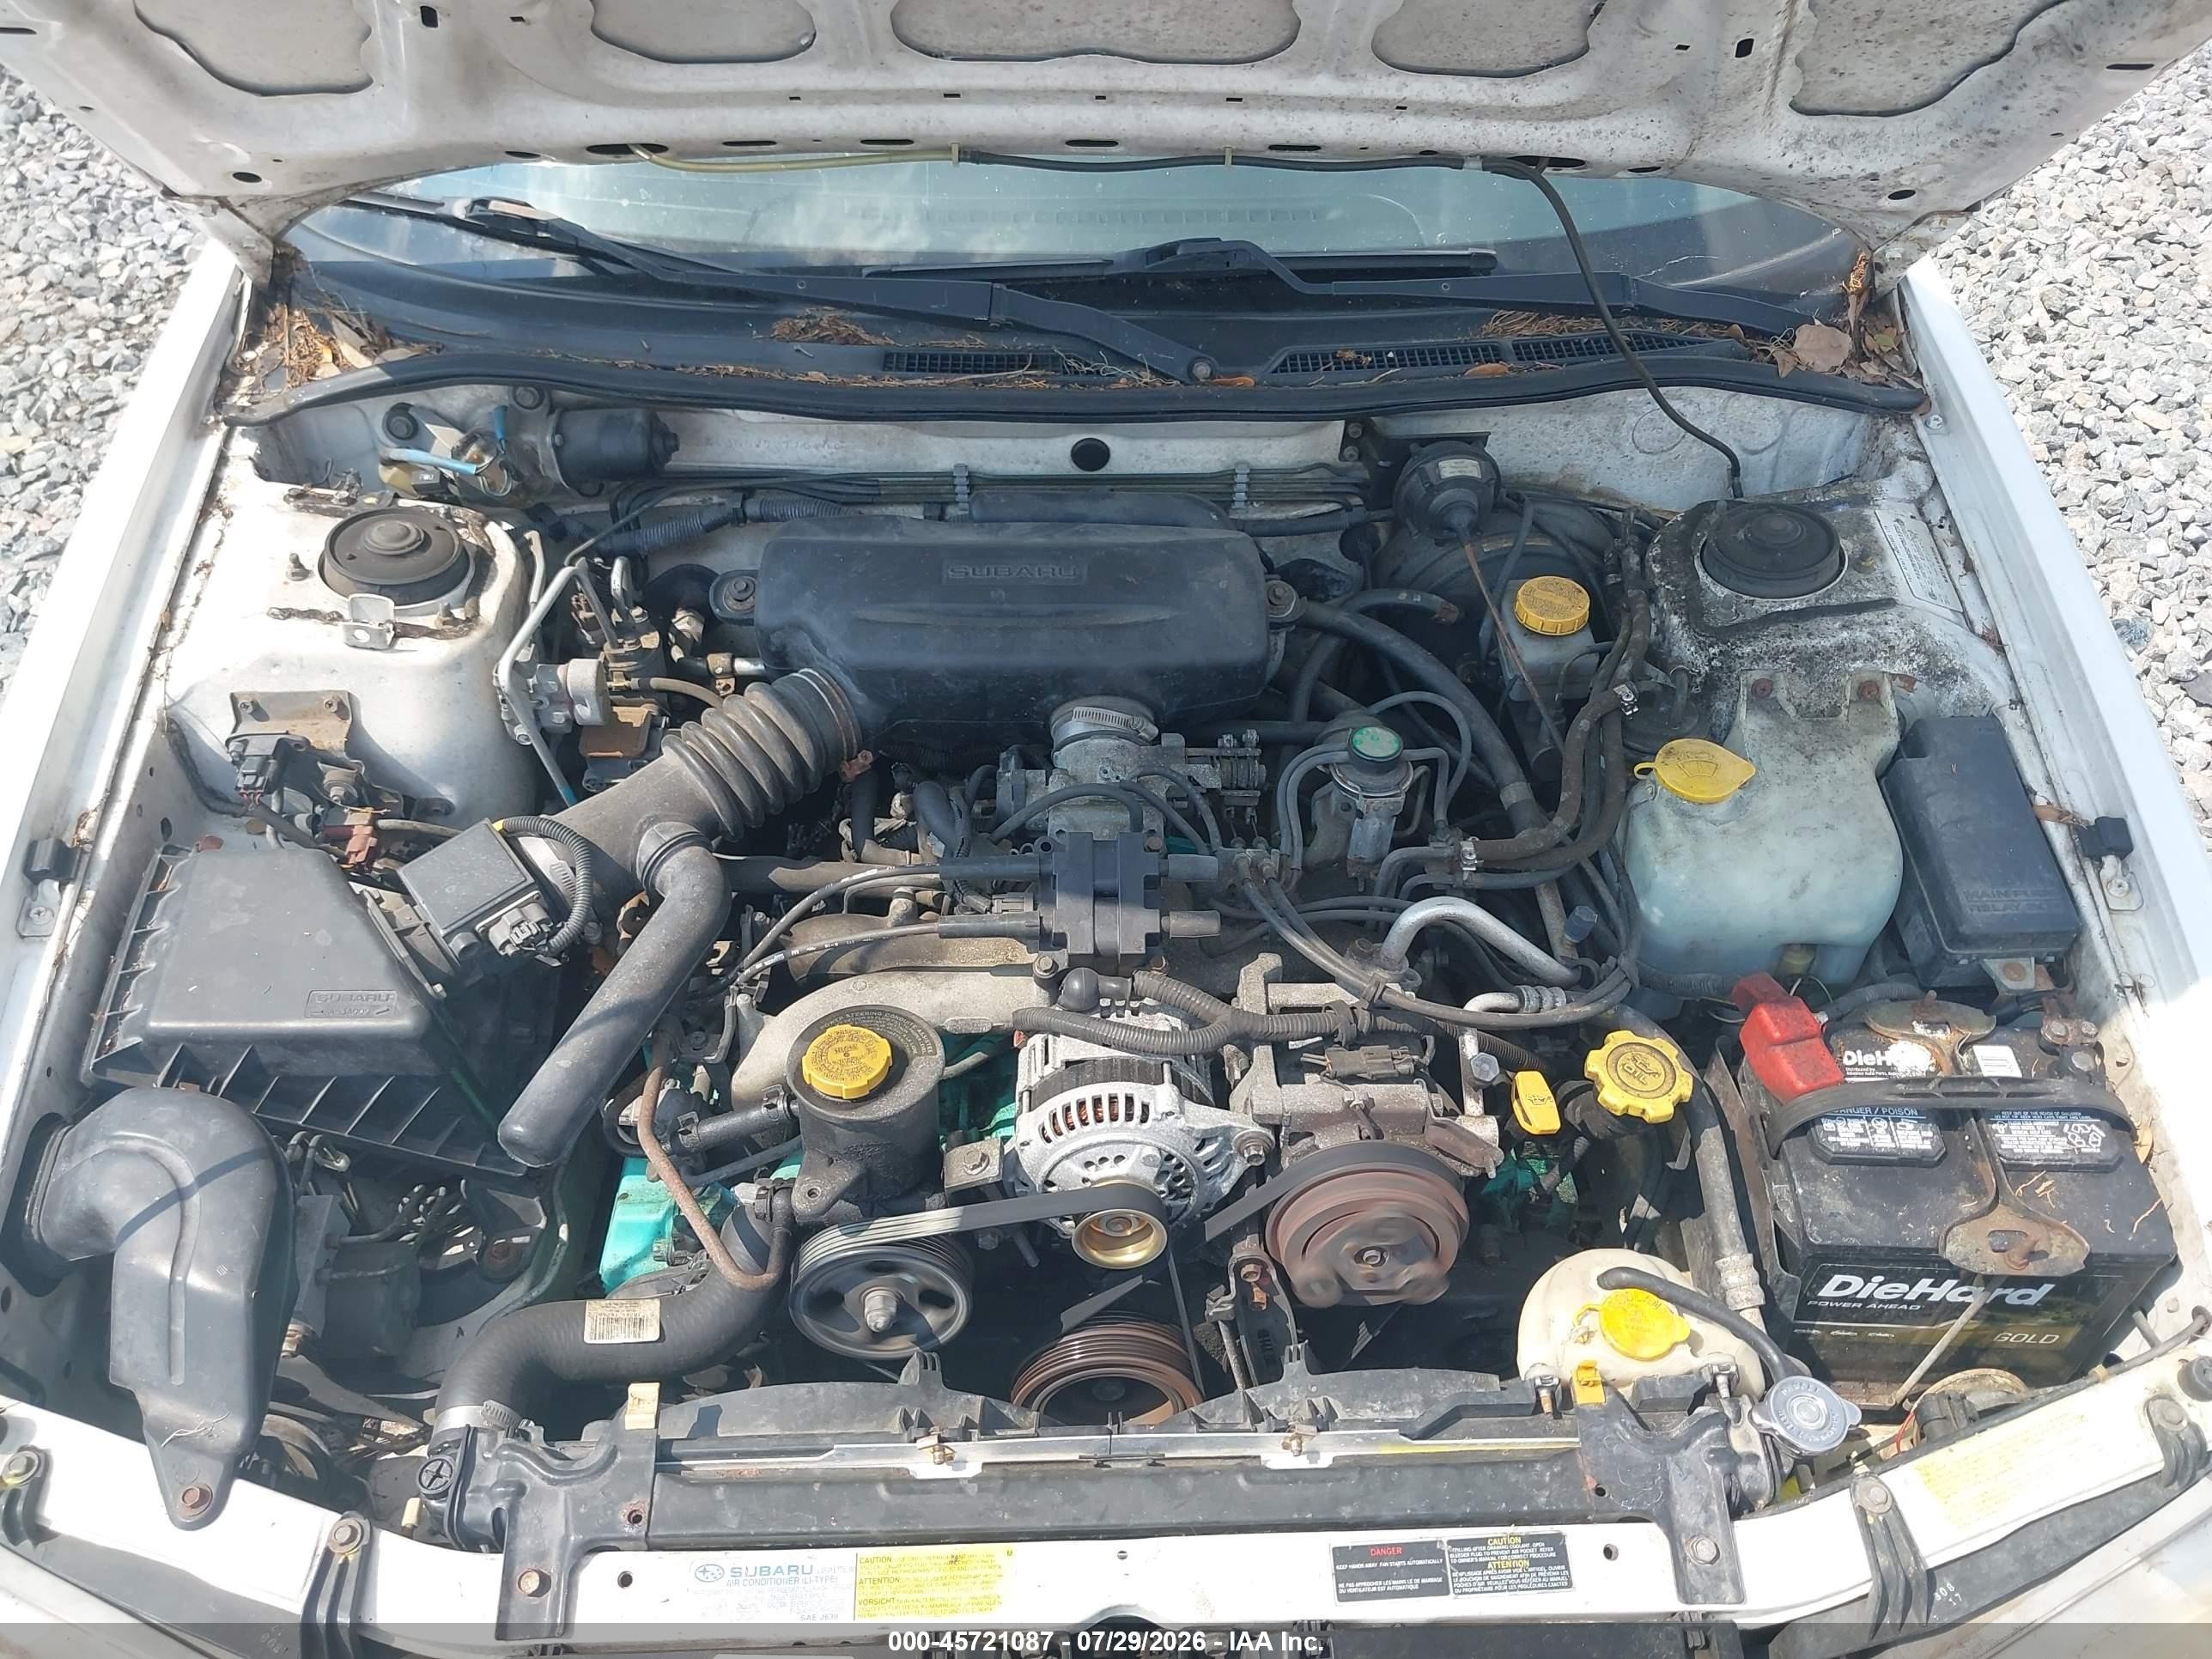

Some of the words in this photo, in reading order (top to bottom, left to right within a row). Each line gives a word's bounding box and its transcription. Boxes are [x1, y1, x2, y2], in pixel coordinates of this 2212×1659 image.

[948, 565, 1077, 578] SUBARU
[315, 994, 390, 1003] SUBARU
[1623, 1063, 1647, 1085] OIL
[1881, 1107, 1918, 1116] POISON
[1817, 1274, 2056, 1306] DieHard
[1807, 1300, 1863, 1309] POWER
[1993, 1332, 2060, 1345] GOLD
[1487, 1536, 1522, 1546] CAUTION
[1370, 1547, 1402, 1556] DANGER
[859, 1556, 892, 1565] CAUTION
[1407, 1558, 1443, 1566] AUTOMATICALLY
[1487, 1559, 1530, 1569] ATTENTION
[730, 1565, 813, 1577] SUBARU
[726, 1578, 740, 1588] AIR
[742, 1577, 799, 1587] CONDITIONER
[858, 1577, 900, 1585] ATTENTION
